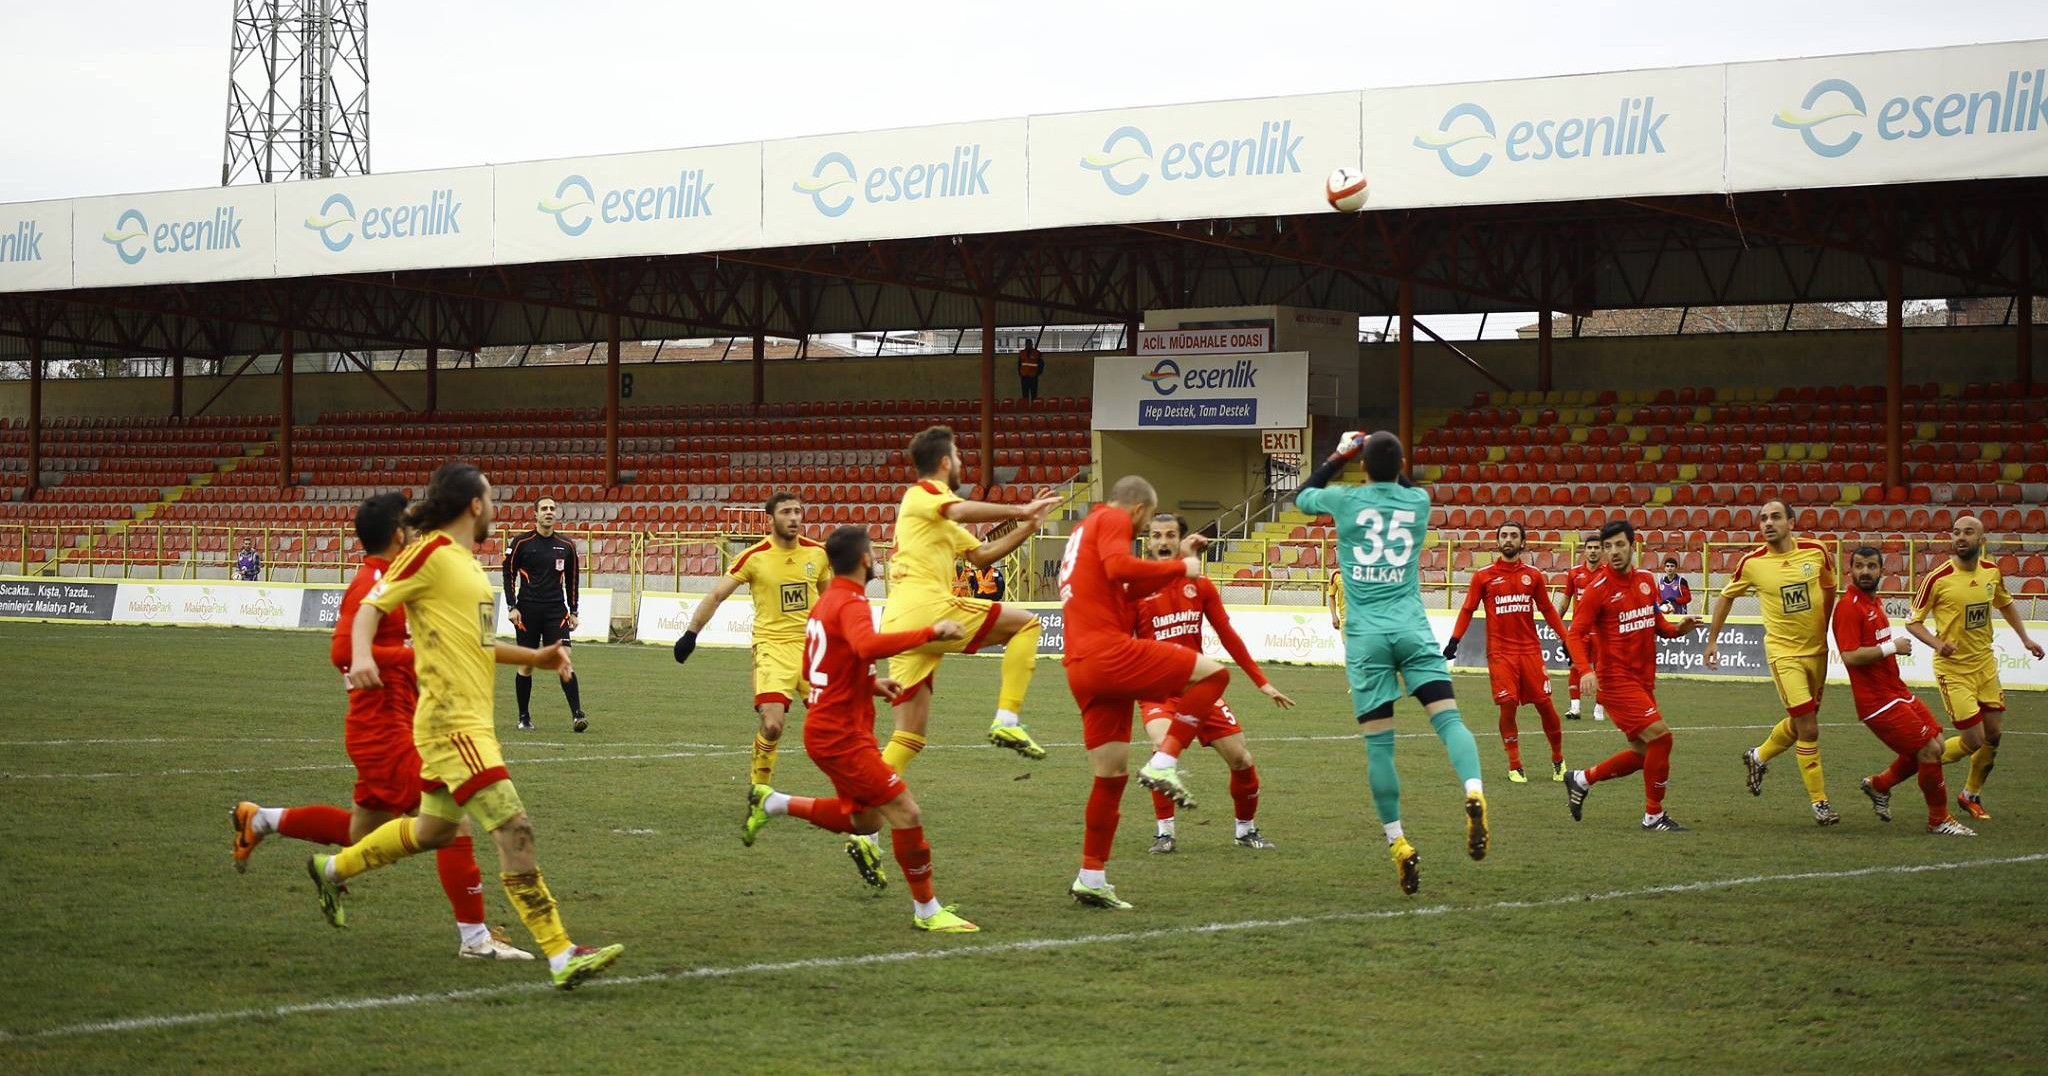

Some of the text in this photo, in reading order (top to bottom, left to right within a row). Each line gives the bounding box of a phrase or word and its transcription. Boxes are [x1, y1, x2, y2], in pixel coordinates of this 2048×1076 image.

[1876, 69, 2048, 141] esenlik
[1505, 96, 1667, 164] esenlik
[1161, 120, 1304, 181] esenlik
[864, 144, 992, 204] esenlik
[601, 170, 713, 224] esenlik
[362, 190, 462, 240] esenlik
[0, 220, 43, 262] nlik
[153, 207, 242, 255] esenlik
[1142, 333, 1263, 350] ACİL MÜDAHALE ODASI
[621, 372, 633, 398] B
[1183, 359, 1258, 389] esenlik
[1144, 403, 1250, 421] Hep Destek, Tam Destek
[1263, 432, 1298, 450] EXIT
[1352, 507, 1416, 567] 35
[38, 584, 62, 599] Kışta,
[64, 585, 95, 598] Yazda...
[784, 589, 804, 604] MK
[1785, 590, 1806, 605] MK
[35, 600, 68, 615] Malatya
[69, 602, 95, 614] Park...
[319, 609, 335, 622] Biz
[1968, 608, 1985, 622] MK
[1221, 705, 1237, 725] 5
